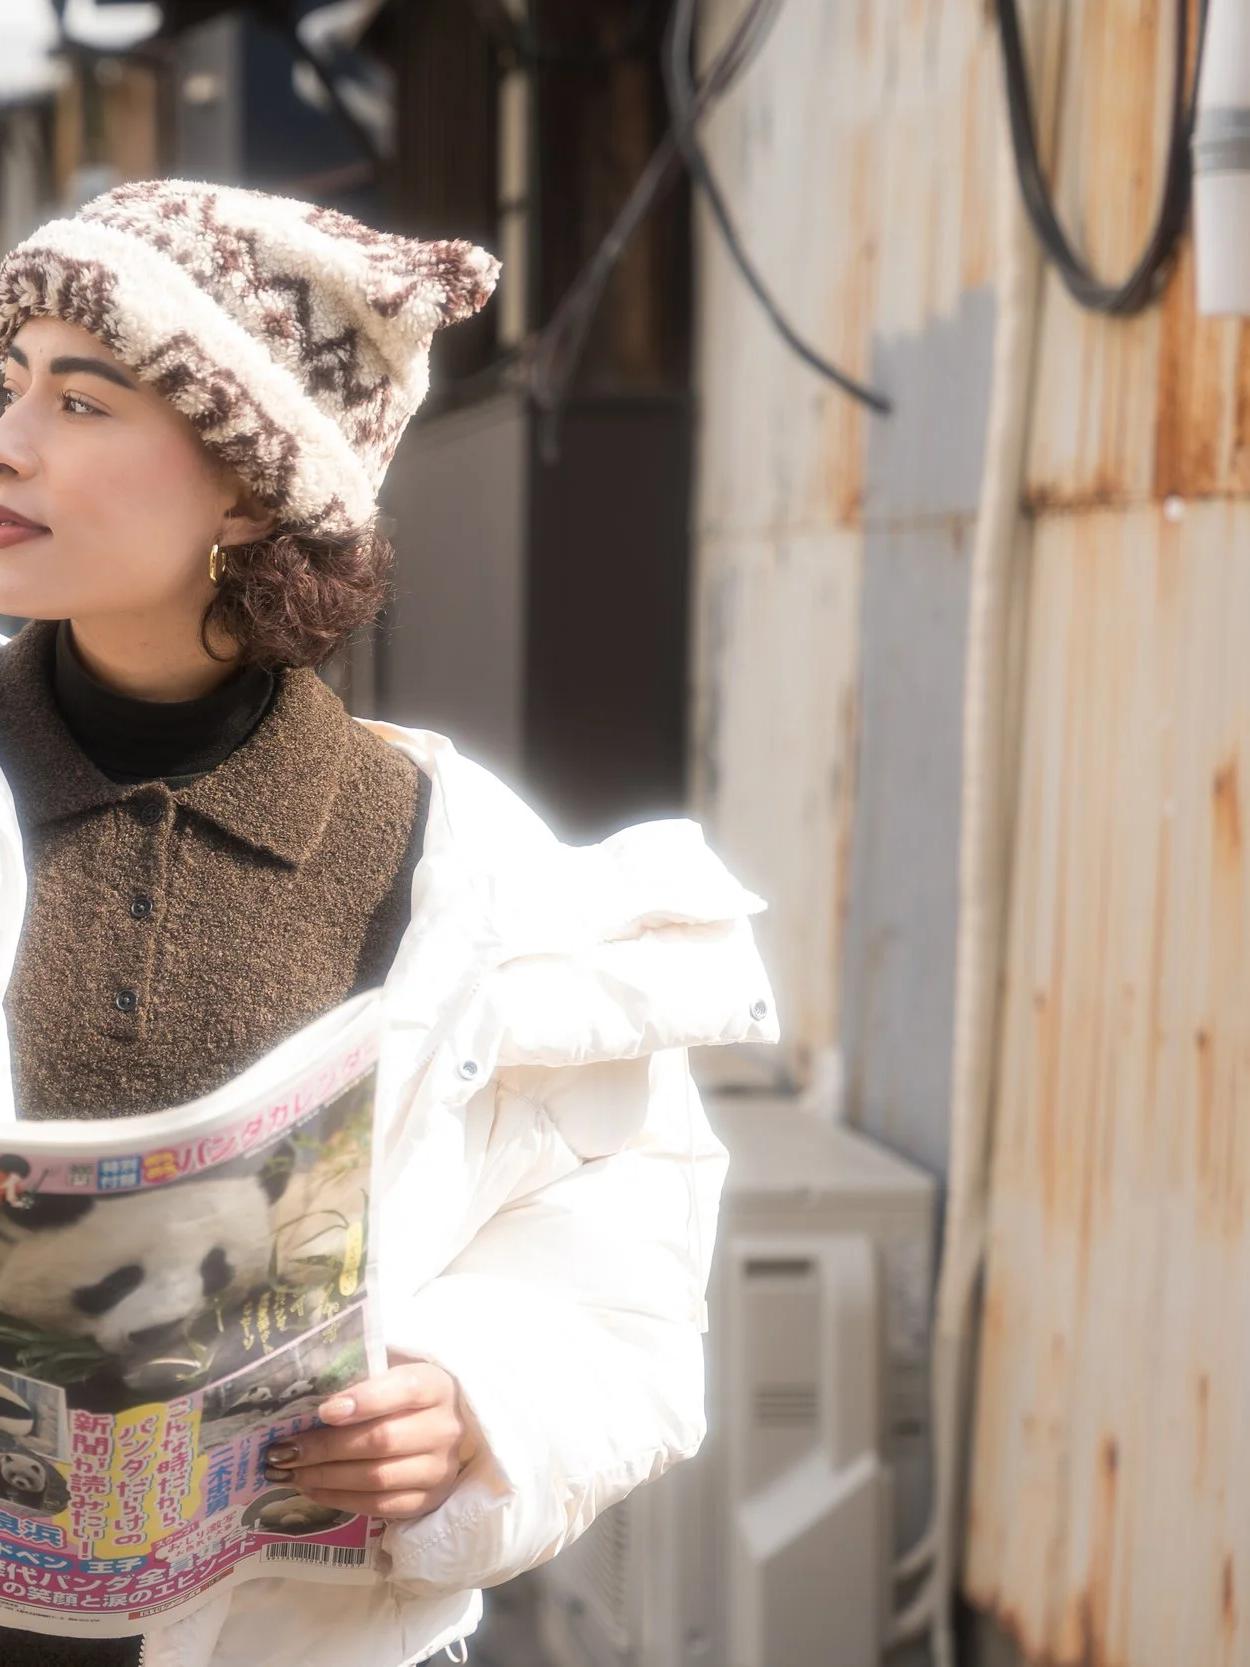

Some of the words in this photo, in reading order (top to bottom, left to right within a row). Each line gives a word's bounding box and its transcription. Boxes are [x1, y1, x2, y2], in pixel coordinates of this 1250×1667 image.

[70, 1411, 111, 1559] 新聞が読みたい!
[114, 1416, 156, 1545] パンダだらけの
[86, 1557, 143, 1575] 王子
